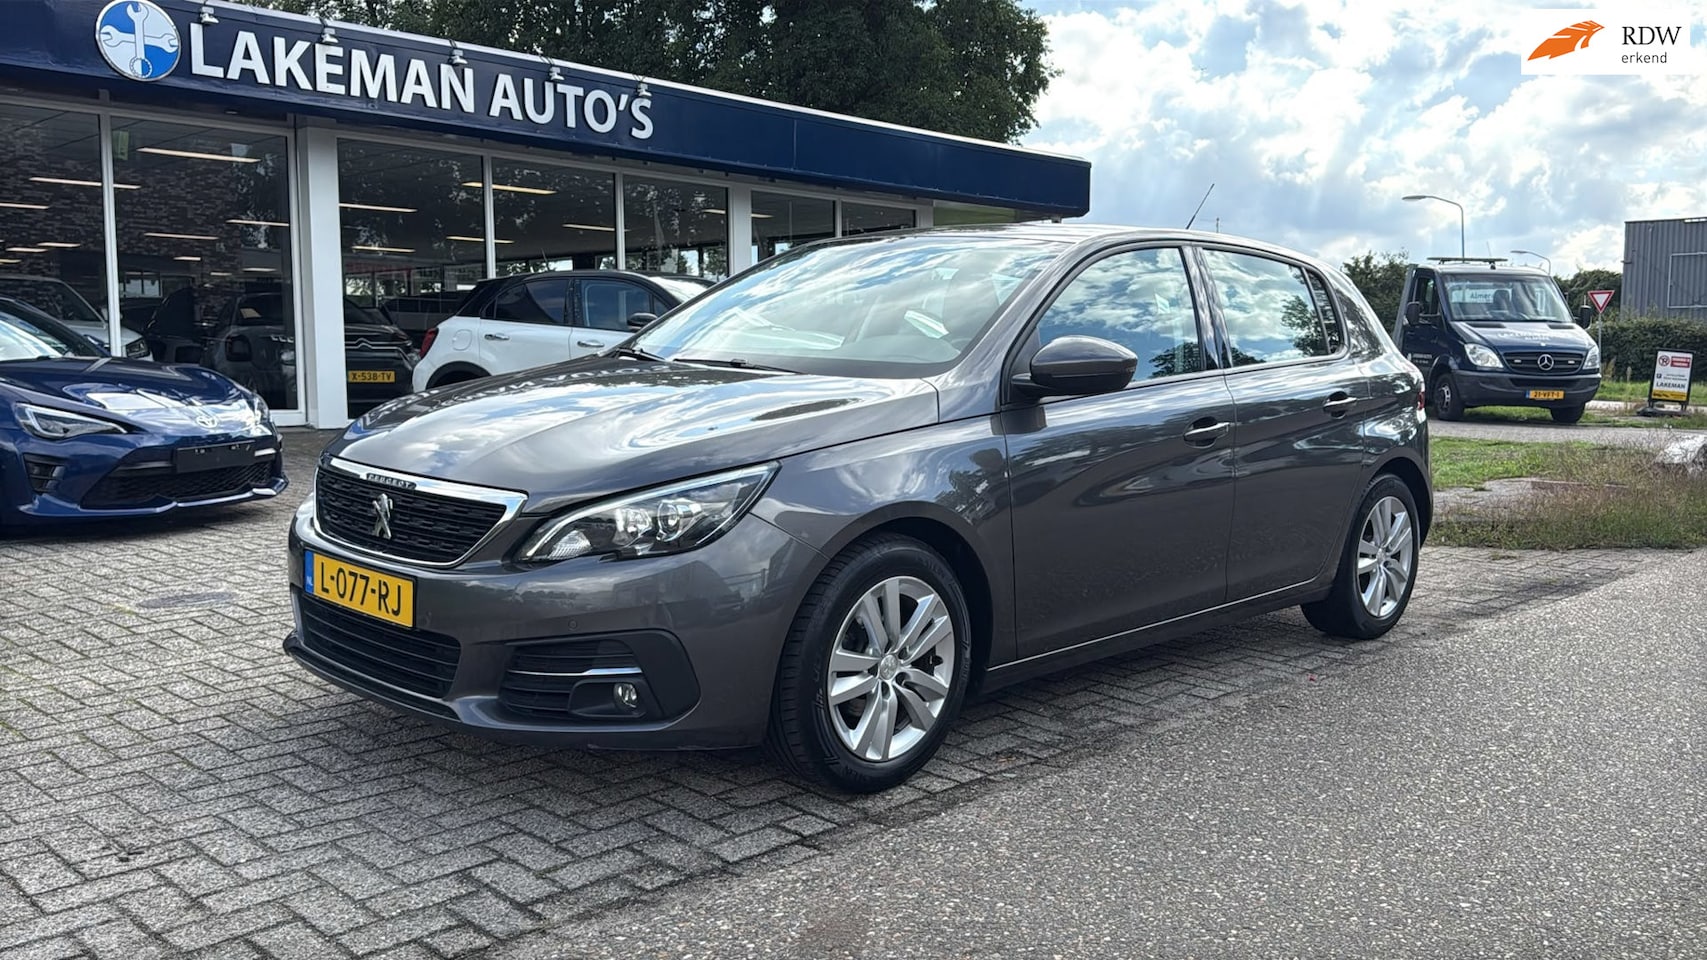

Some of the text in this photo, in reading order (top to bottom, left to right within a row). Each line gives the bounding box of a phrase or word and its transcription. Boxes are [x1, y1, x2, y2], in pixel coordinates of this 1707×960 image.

[190, 22, 654, 139] LAKEMAN AUTO'S
[351, 371, 392, 381] X-538-TV
[368, 473, 411, 489] PEUGEOT
[321, 561, 401, 617] L-077-RJ
